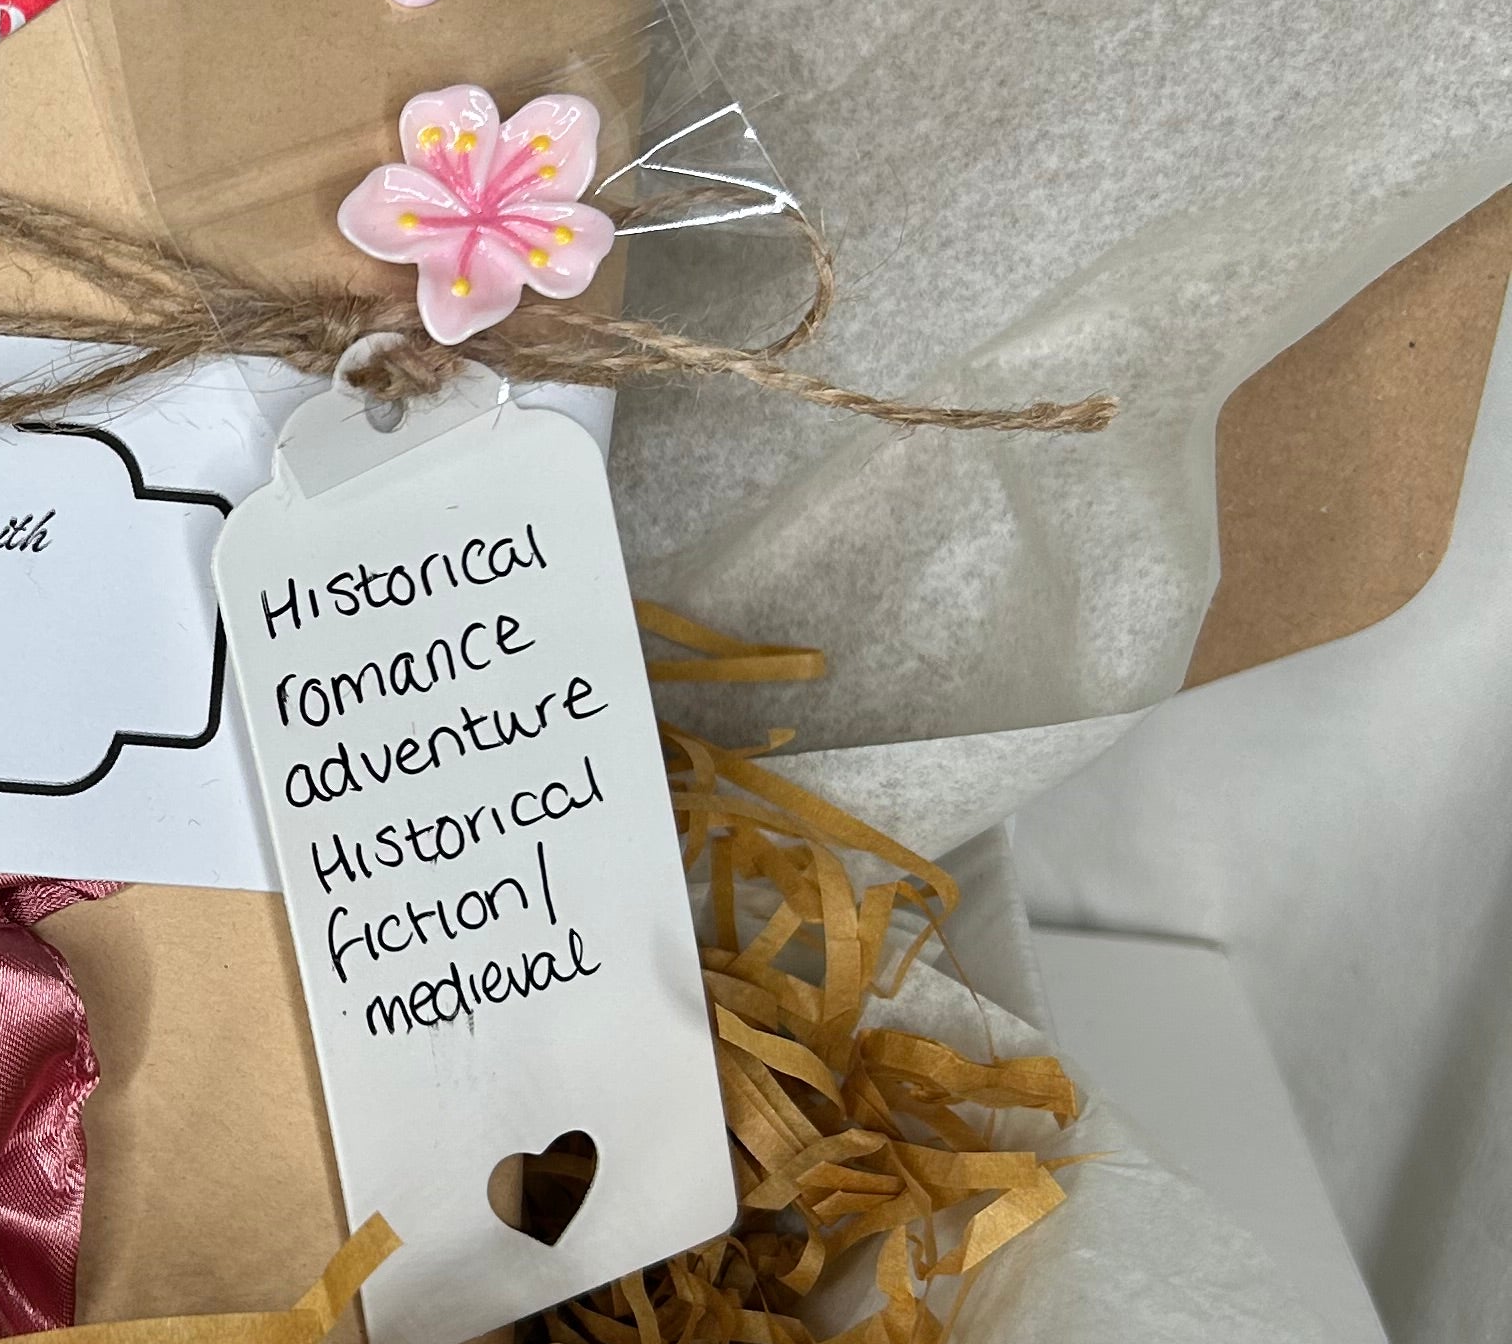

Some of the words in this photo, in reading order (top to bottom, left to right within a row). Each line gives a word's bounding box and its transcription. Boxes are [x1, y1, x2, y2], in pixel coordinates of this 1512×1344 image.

[260, 523, 548, 640] Historical
[275, 613, 536, 727] romance
[285, 675, 610, 808] adventure
[311, 755, 605, 895] Historical
[365, 927, 602, 1037] medieval
